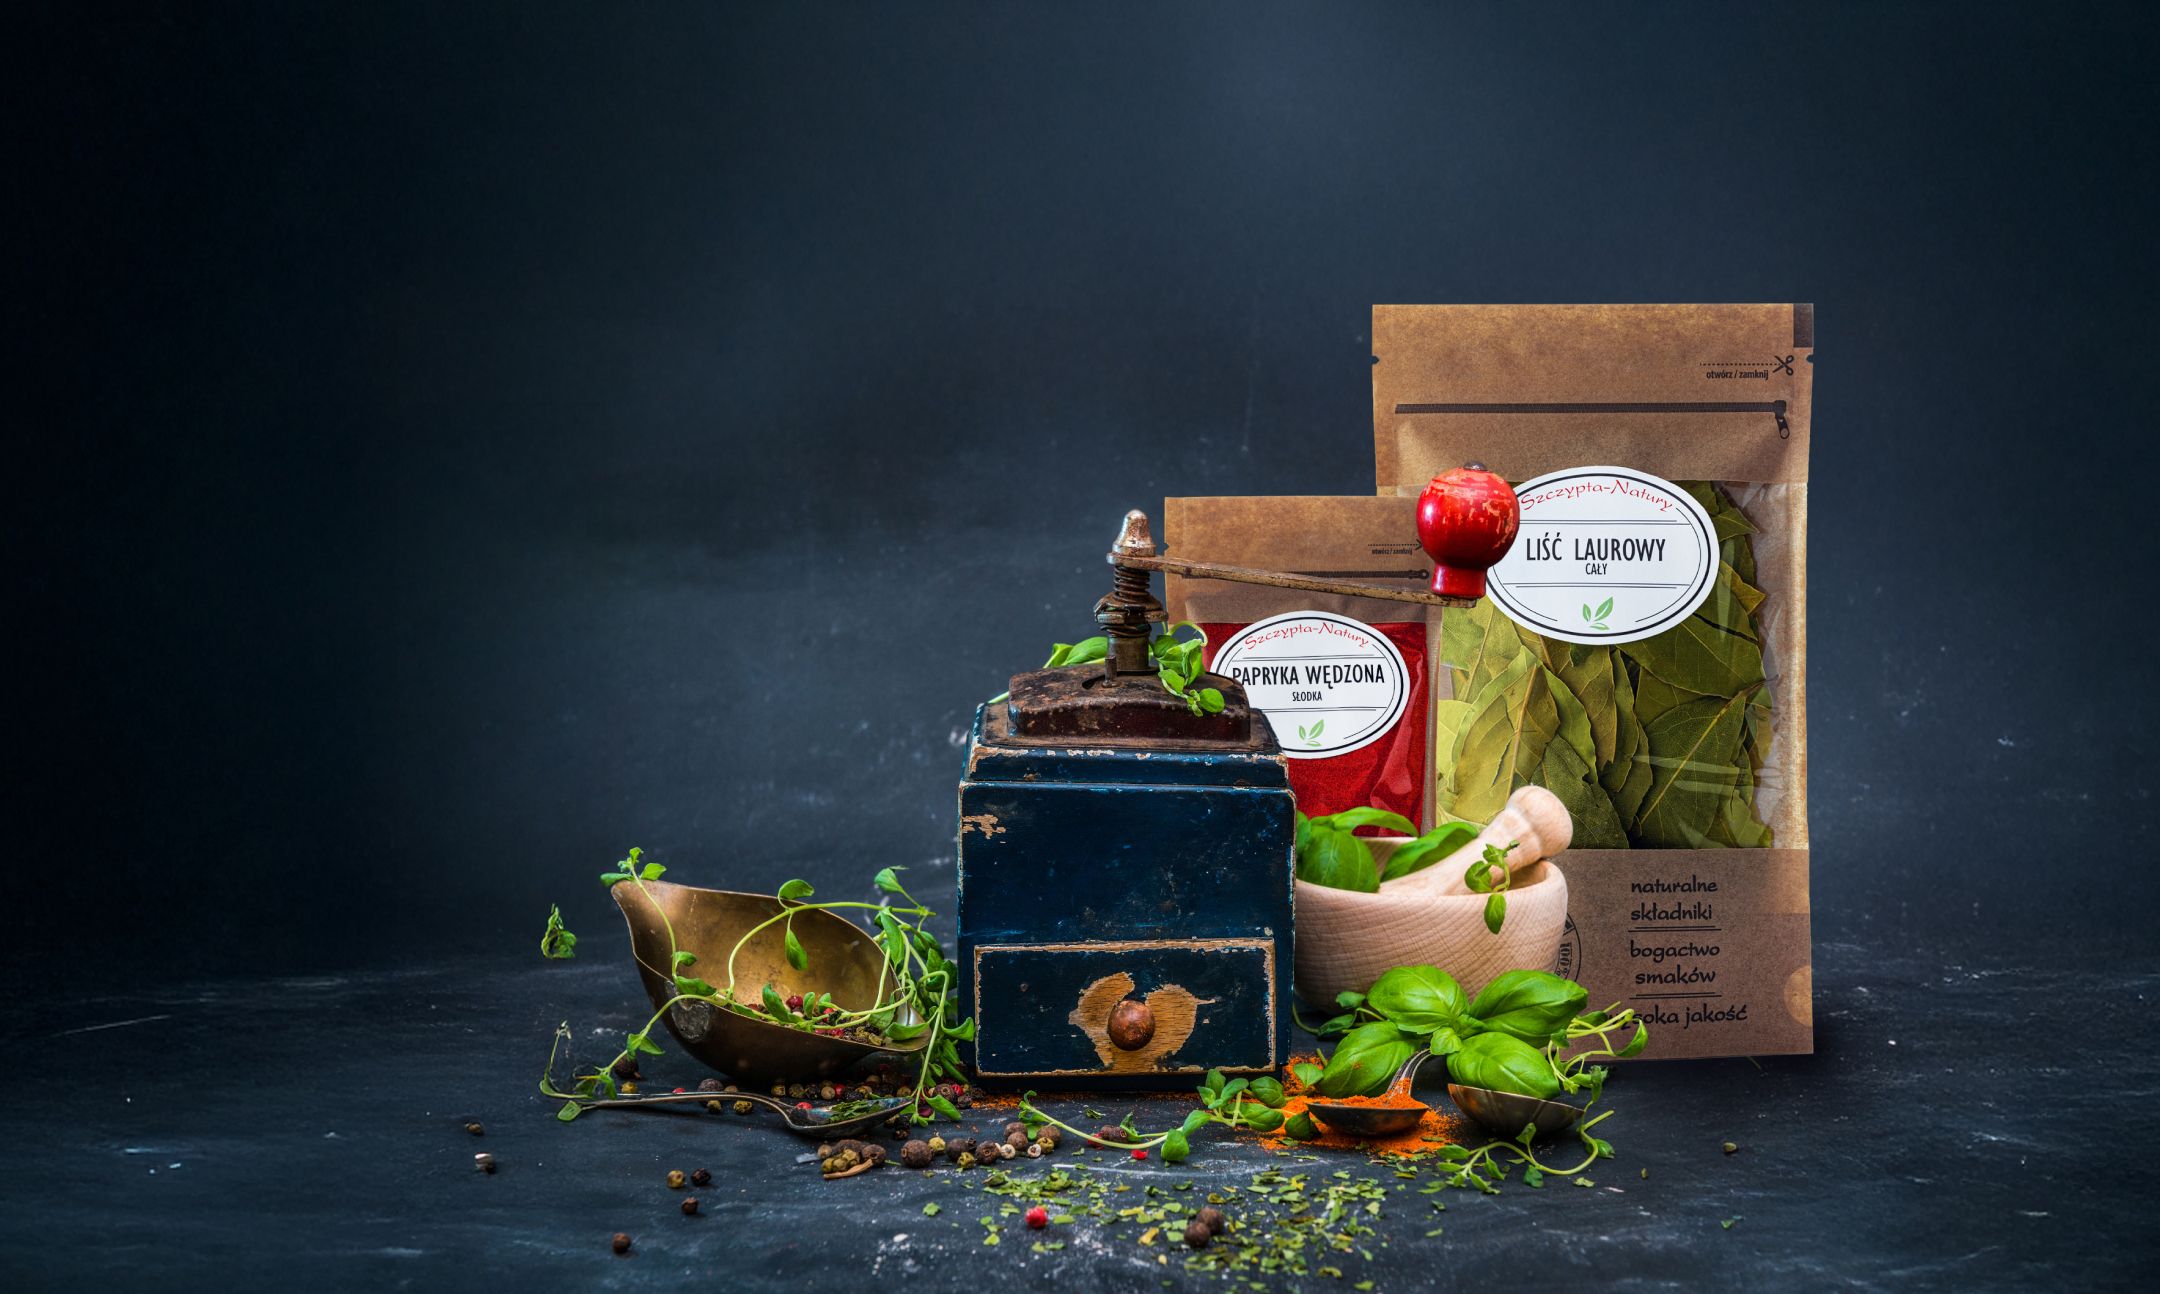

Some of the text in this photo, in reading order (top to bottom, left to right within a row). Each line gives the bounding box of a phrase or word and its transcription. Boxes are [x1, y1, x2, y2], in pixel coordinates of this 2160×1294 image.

[1706, 369, 1733, 379] otwórz
[1739, 369, 1769, 381] zamknij
[1520, 479, 1673, 512] Szczypta-Natury
[1526, 532, 1666, 562] LIŚĆ LAUROWY
[1585, 563, 1608, 575] CAŁY
[1244, 622, 1369, 650] Szczypta-Natury
[1232, 664, 1385, 689] PAPRYKA WĘDZONA
[1292, 691, 1322, 702] SŁODKA
[1631, 874, 1718, 893] naturalne
[1630, 901, 1713, 921] składniki
[1630, 940, 1720, 963] bogactwo
[1635, 964, 1716, 985] smaków
[1683, 1003, 1748, 1029] jakość
